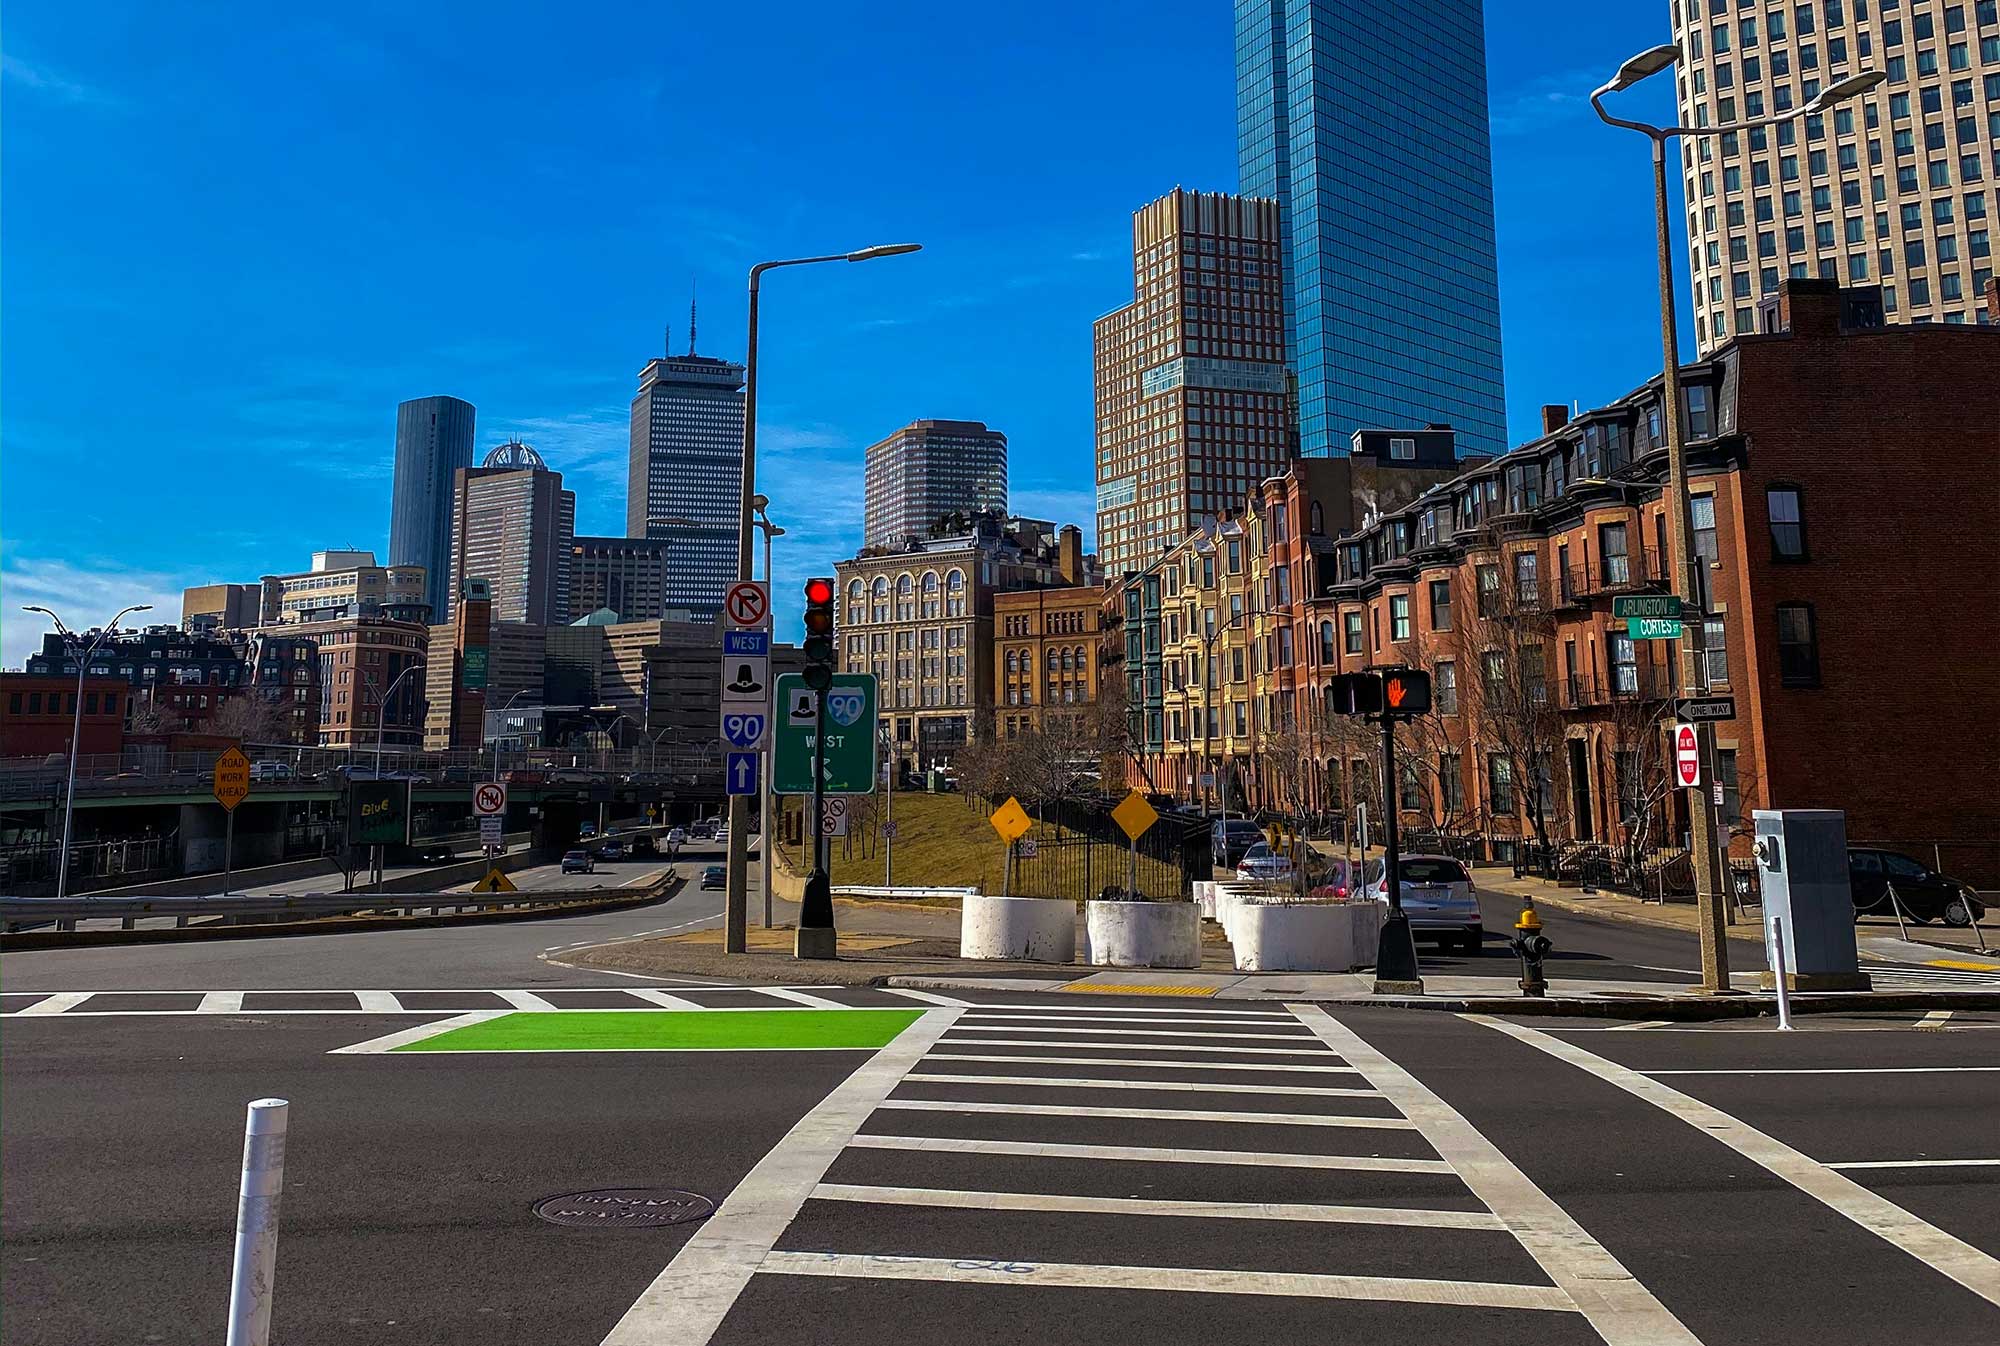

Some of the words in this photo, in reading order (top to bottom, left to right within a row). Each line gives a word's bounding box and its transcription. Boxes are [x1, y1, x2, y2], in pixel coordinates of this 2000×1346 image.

[671, 365, 730, 375] PRUDENTIAL
[1622, 598, 1668, 616] ARLINGTON
[1669, 605, 1676, 615] ST
[1640, 619, 1672, 636] CORTES
[1673, 624, 1679, 633] ST
[732, 636, 760, 650] WEST
[832, 696, 860, 718] 90
[1690, 704, 1708, 716] ONE
[1711, 703, 1729, 715] WAY
[728, 716, 760, 739] 90
[806, 735, 845, 748] WST
[221, 757, 244, 769] ROAD
[220, 772, 243, 783] WORK
[217, 786, 245, 797] AHEAD
